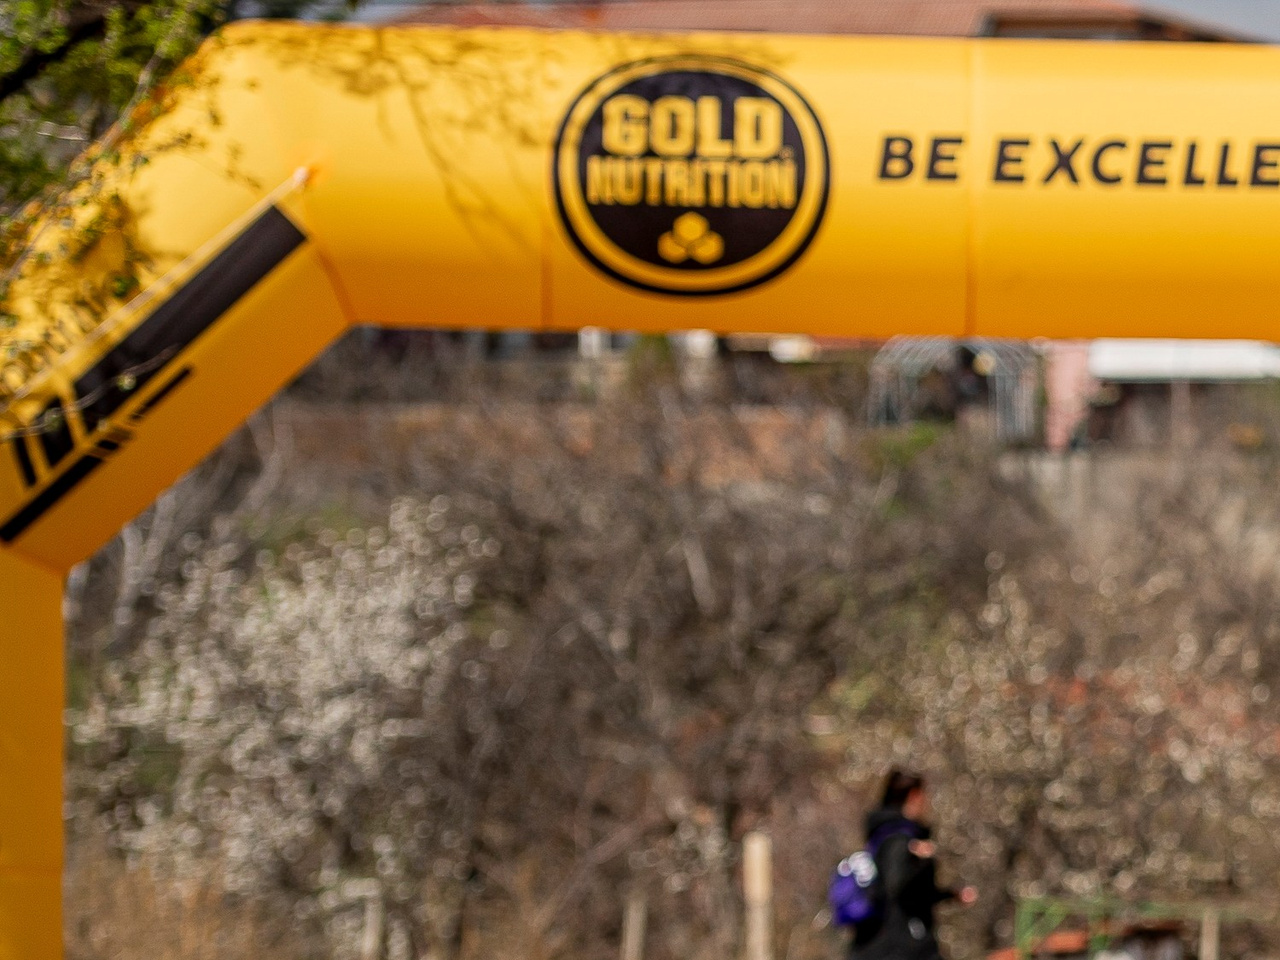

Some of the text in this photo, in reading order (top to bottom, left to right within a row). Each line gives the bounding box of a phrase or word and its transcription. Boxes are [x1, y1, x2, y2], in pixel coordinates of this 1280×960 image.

[601, 94, 782, 157] GOLD
[586, 155, 796, 208] NUTRITION
[878, 136, 964, 180] BE
